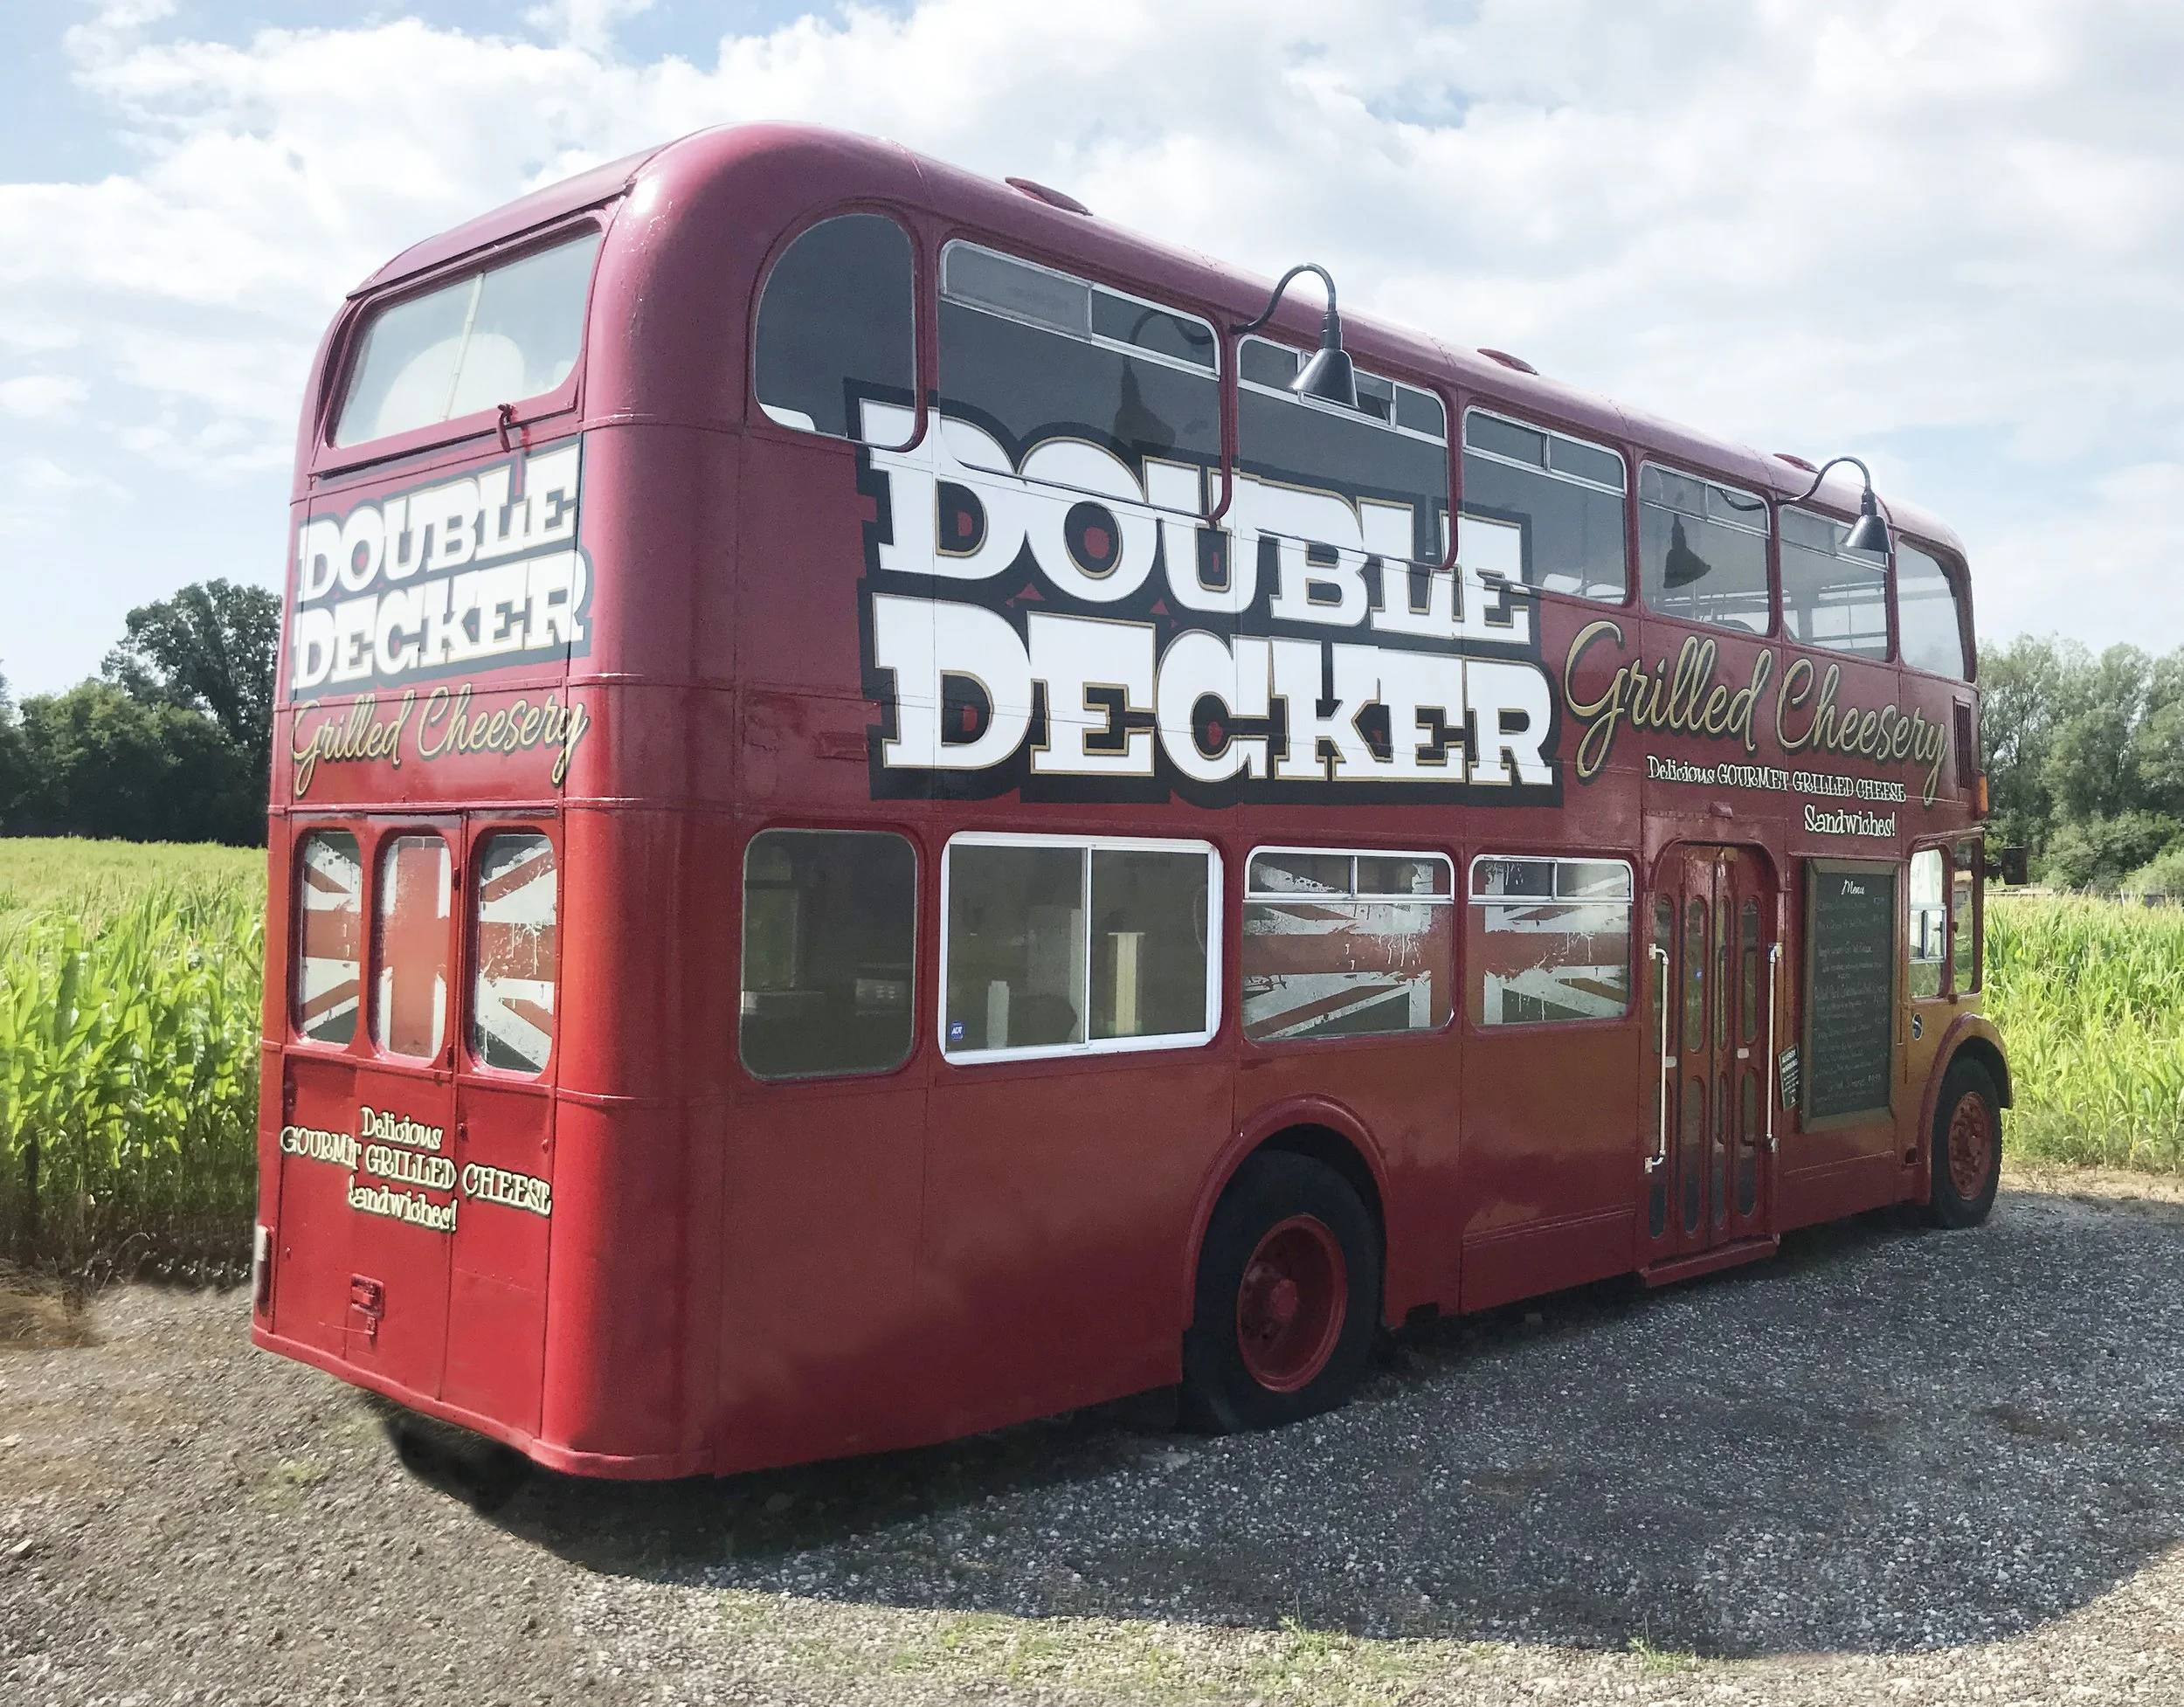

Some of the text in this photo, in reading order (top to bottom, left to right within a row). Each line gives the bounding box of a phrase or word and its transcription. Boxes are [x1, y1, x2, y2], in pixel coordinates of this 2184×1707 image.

[298, 446, 579, 602] DOUBLE
[860, 398, 1531, 642] DOUBLE
[292, 549, 587, 690] DECKER
[292, 683, 590, 797] Grilled Cheesery
[874, 593, 1553, 784] DECKER
[1565, 621, 1947, 805] Grilled Cheesery
[1647, 756, 1906, 803] Delicious GOURMET GRILLED CHEESE
[1804, 805, 1897, 837] Sandwiches!
[1841, 879, 1865, 895] Menu
[360, 1106, 443, 1151] Delicious
[364, 1144, 457, 1191] GRILLED
[461, 1163, 553, 1217] CHEESE
